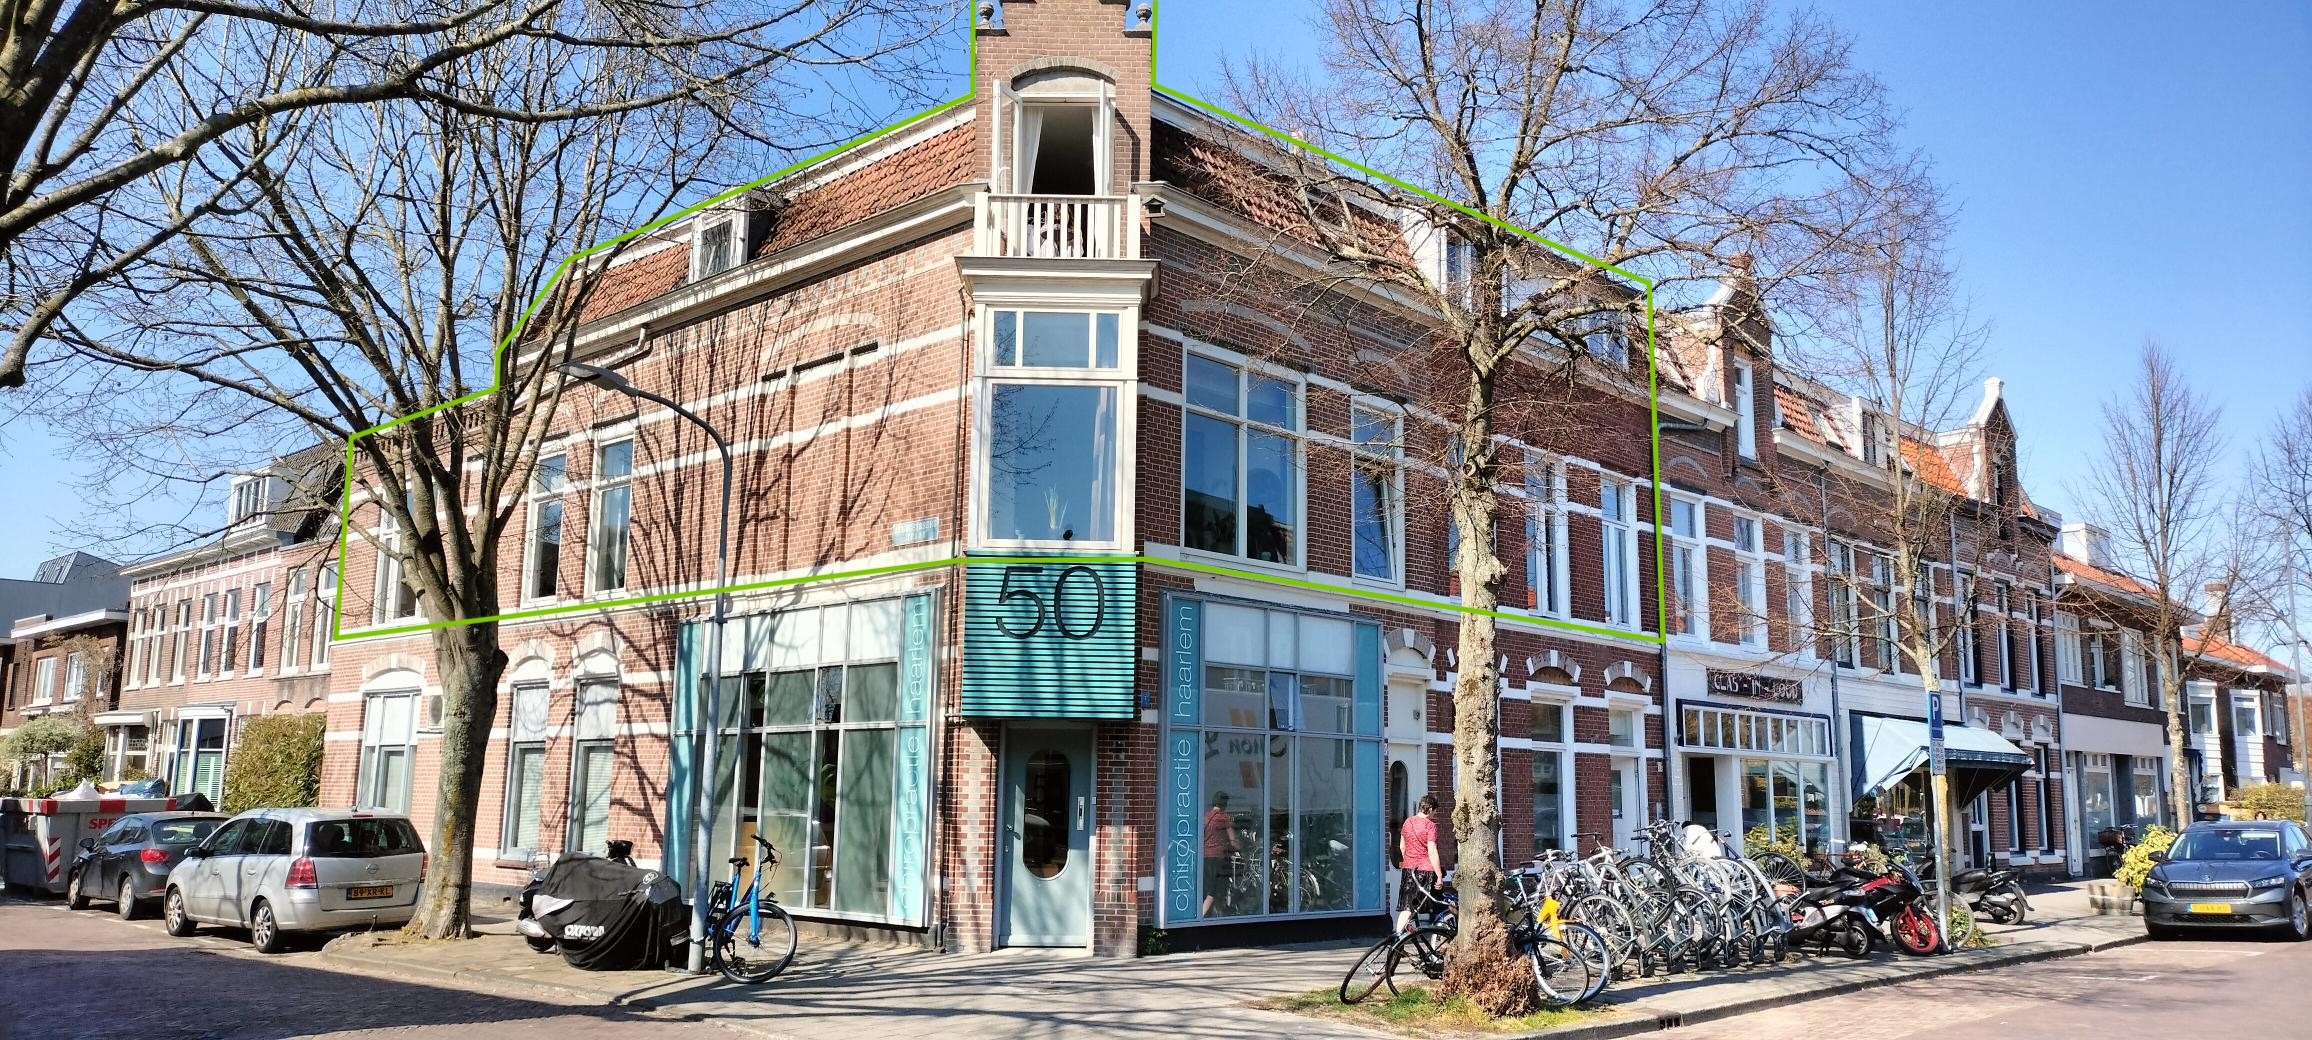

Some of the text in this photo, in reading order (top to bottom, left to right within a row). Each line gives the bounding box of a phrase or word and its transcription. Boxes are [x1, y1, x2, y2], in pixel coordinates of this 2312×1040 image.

[996, 565, 1105, 640] 50
[905, 602, 925, 714] haarlem
[1932, 696, 1940, 720] P
[1171, 606, 1193, 912] chiropractie haarlem
